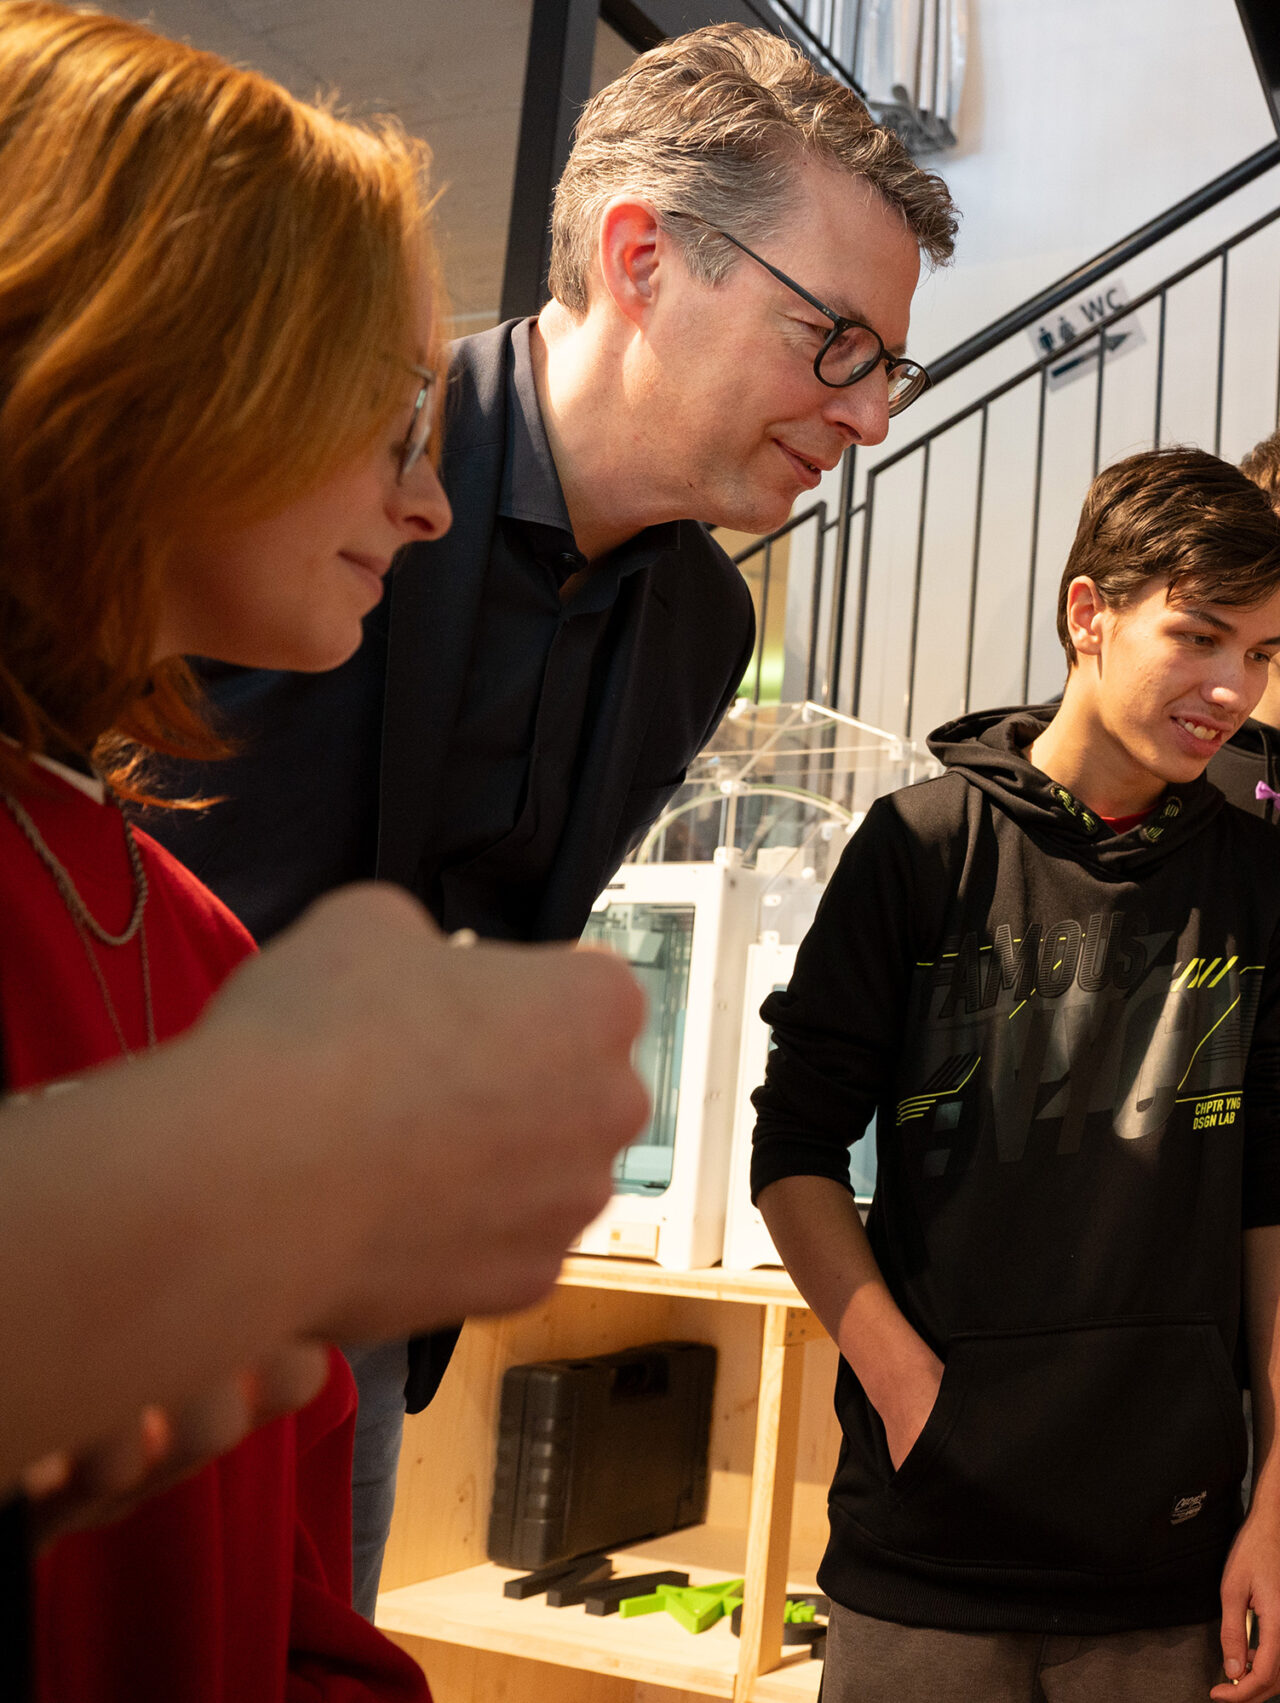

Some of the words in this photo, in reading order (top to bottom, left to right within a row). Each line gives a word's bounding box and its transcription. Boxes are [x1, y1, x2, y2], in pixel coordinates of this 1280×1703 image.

[1079, 287, 1125, 322] WC
[1195, 1098, 1224, 1116] CHPTR
[1192, 1113, 1218, 1130] DSGN
[1217, 1111, 1236, 1126] LAB
